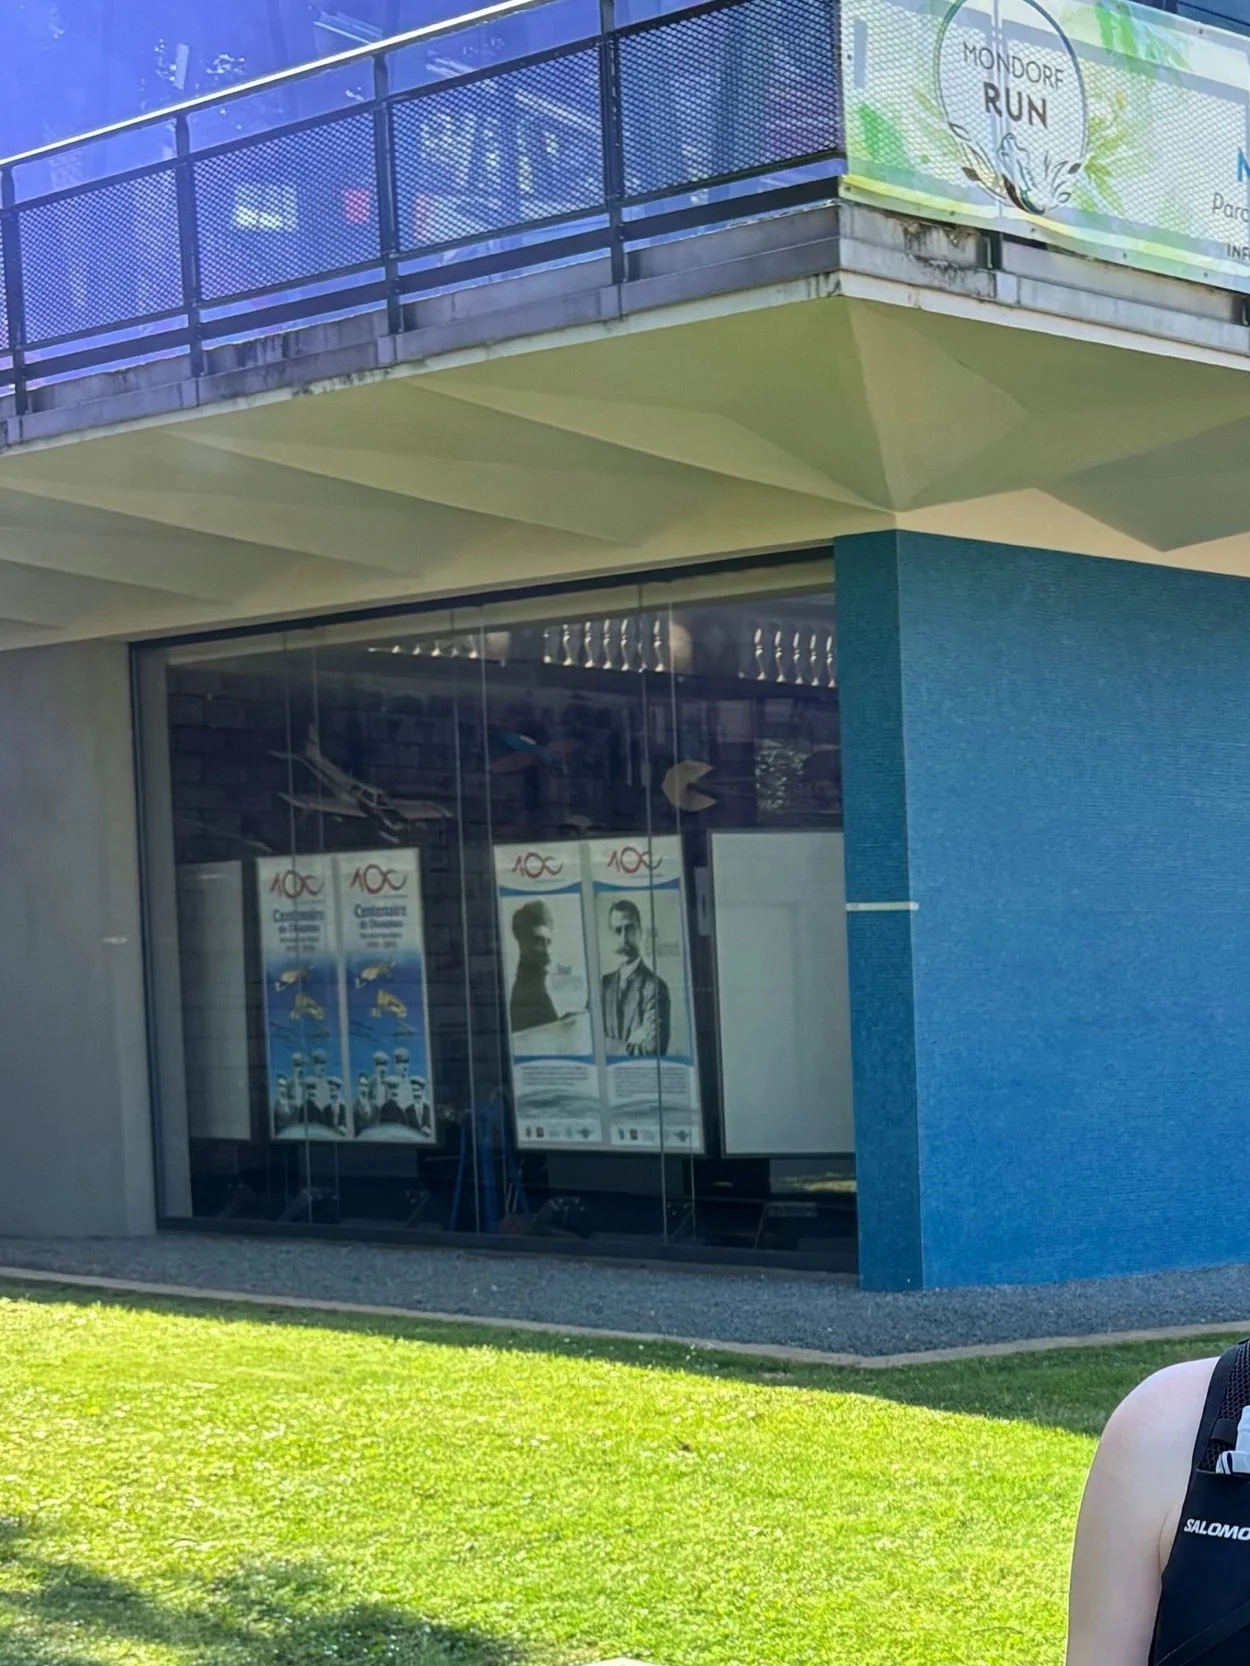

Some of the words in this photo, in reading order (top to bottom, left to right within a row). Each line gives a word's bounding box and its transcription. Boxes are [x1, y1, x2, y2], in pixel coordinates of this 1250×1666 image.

[963, 41, 1064, 89] MONDORF
[983, 81, 1048, 129] RUN
[1211, 192, 1250, 223] Parc
